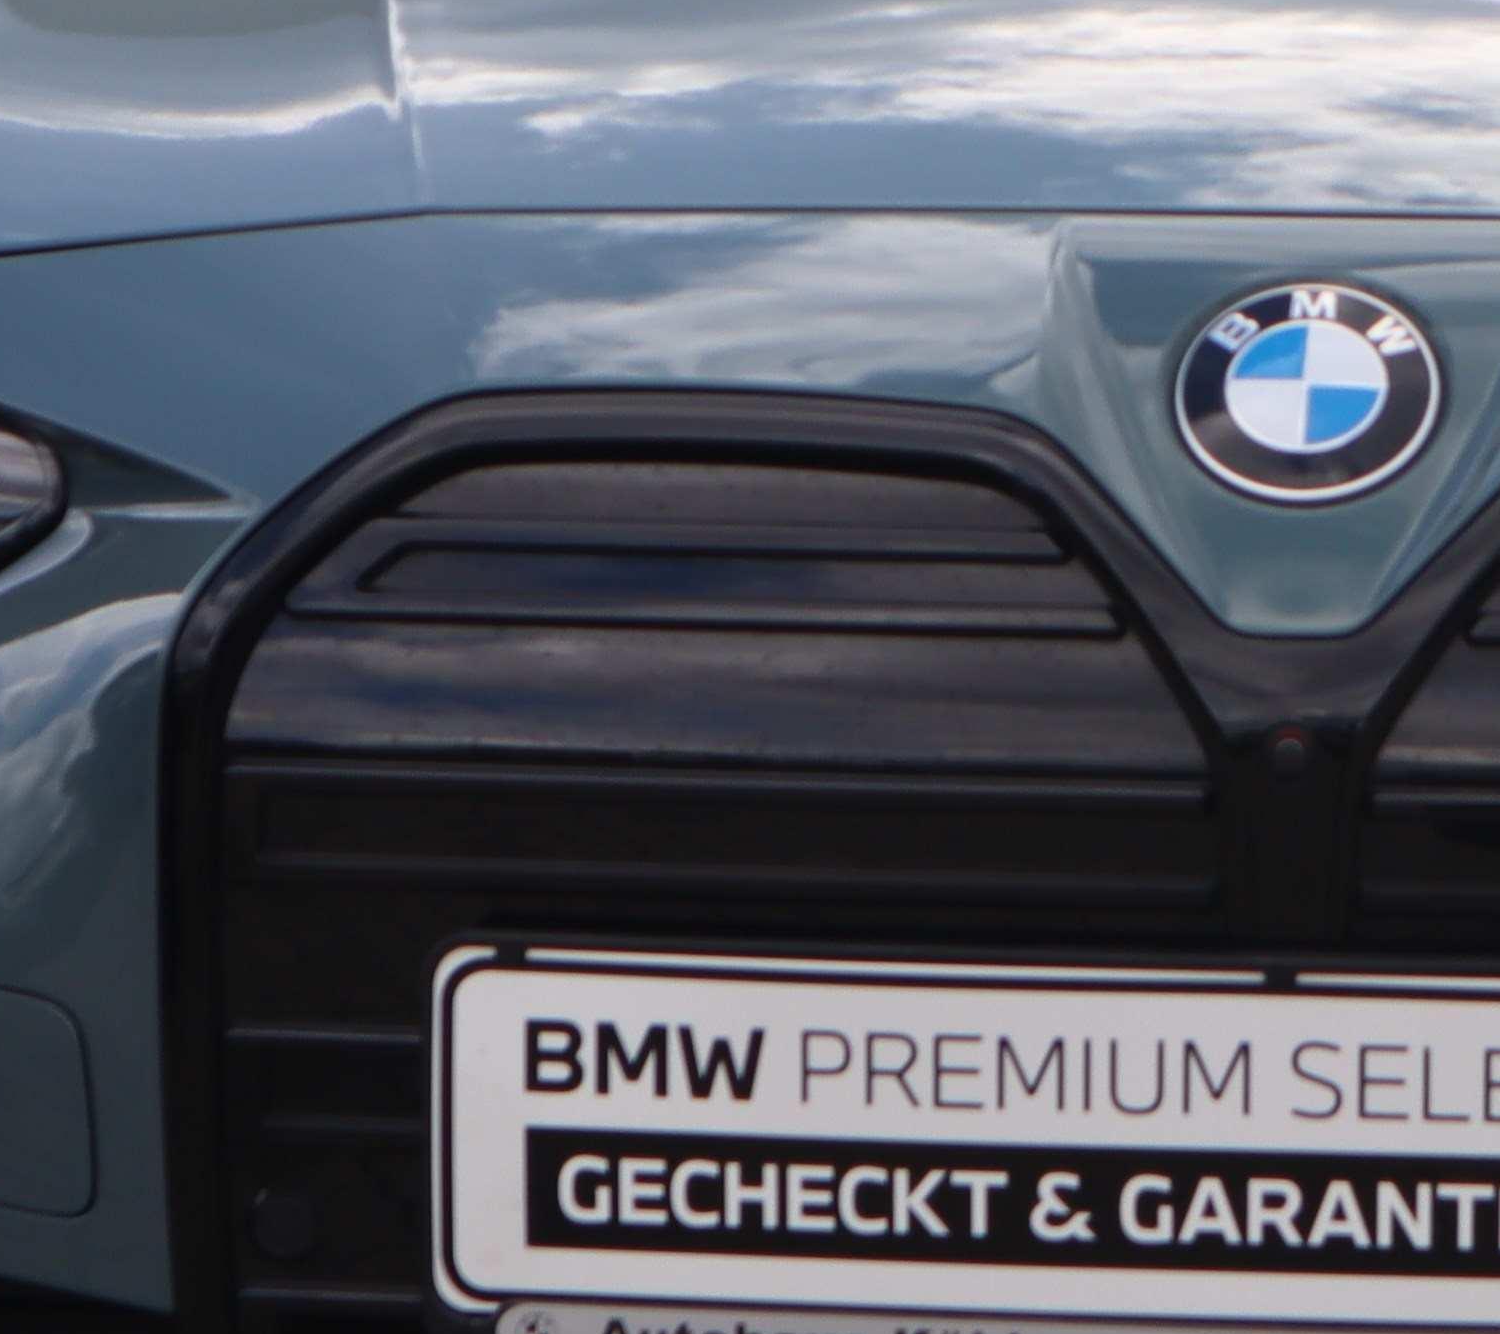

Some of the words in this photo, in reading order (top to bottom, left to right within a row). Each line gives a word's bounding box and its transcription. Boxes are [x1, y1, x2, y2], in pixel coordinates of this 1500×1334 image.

[1208, 289, 1417, 357] BMW
[524, 1017, 765, 1101] BMW
[800, 1029, 1253, 1115] PREMIUM
[556, 1154, 1008, 1238] GECHECKT
[1028, 1172, 1096, 1242] &
